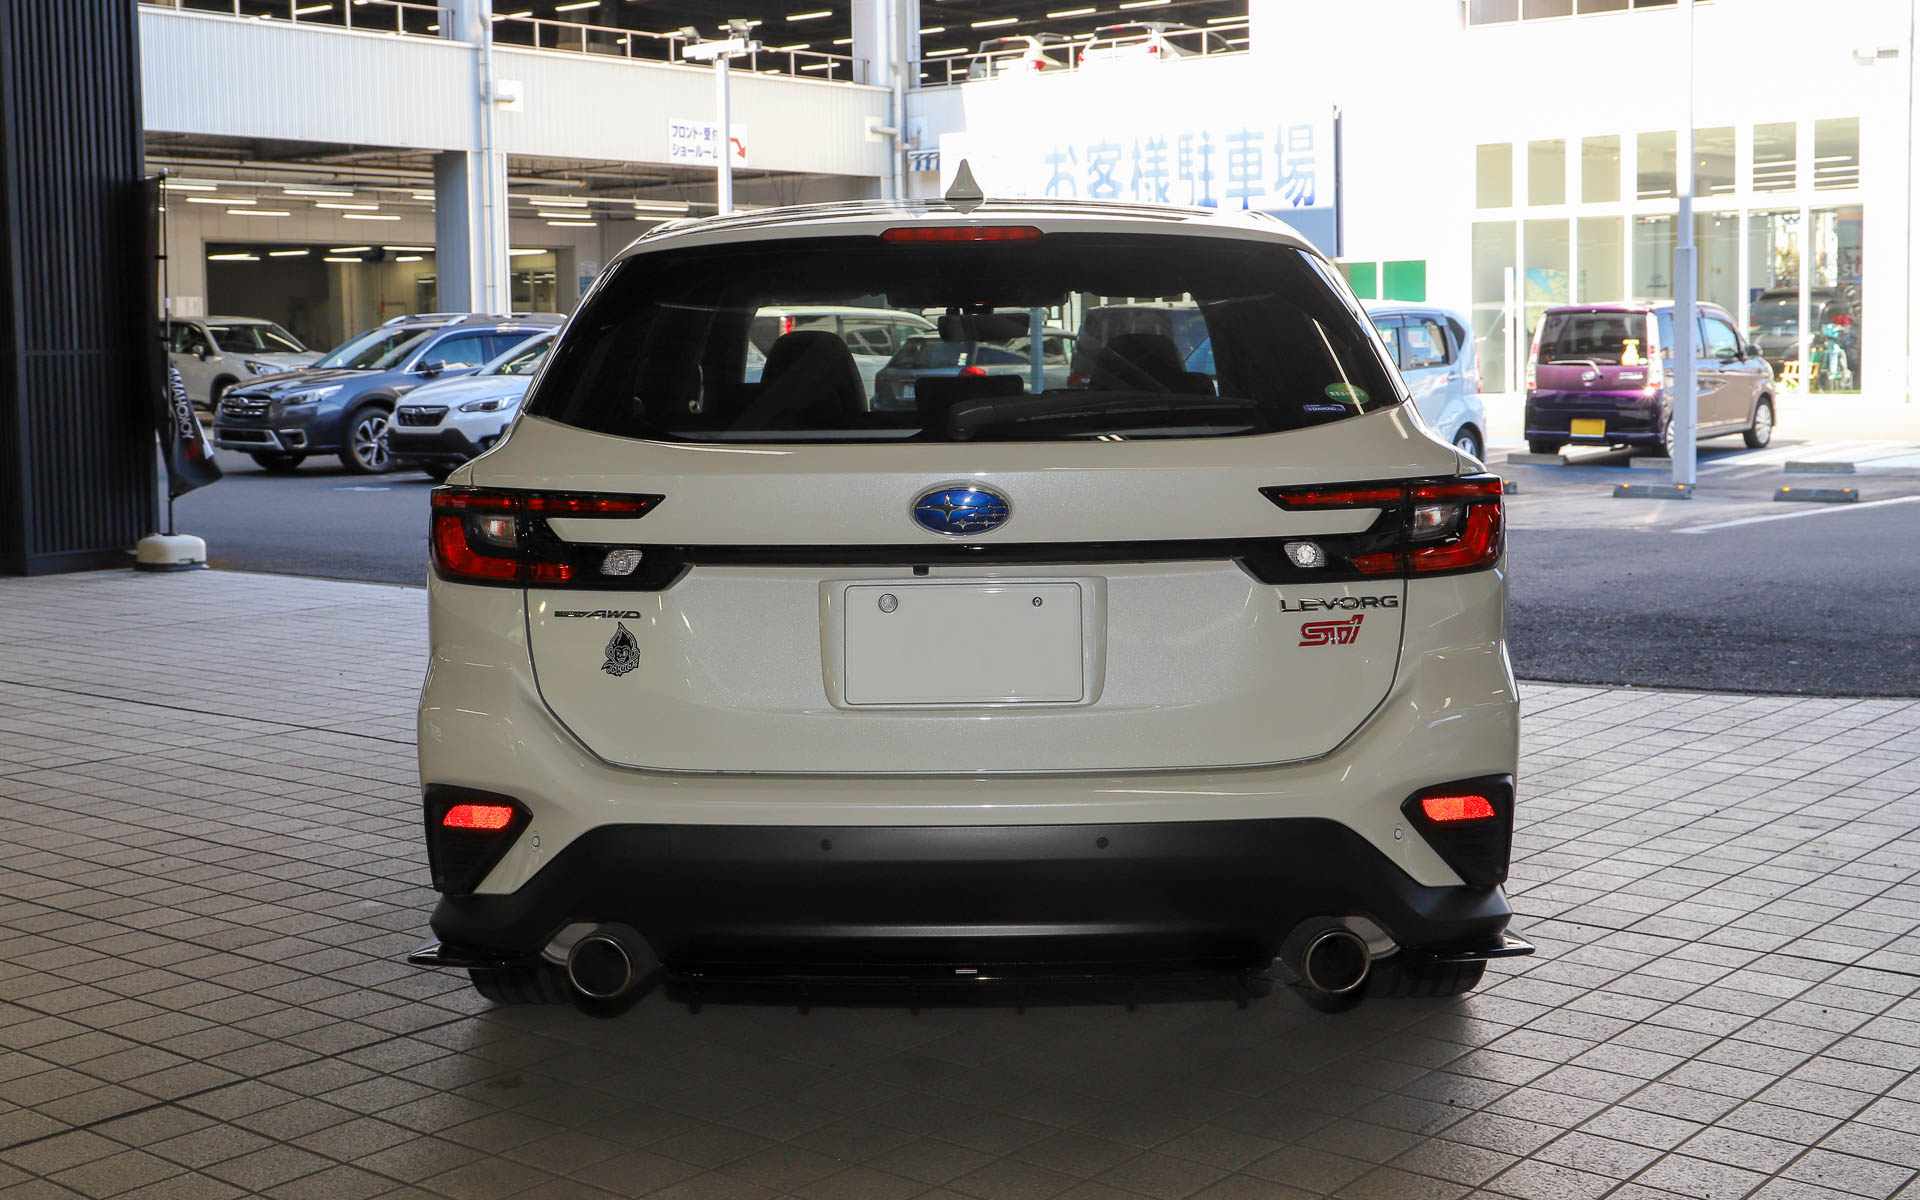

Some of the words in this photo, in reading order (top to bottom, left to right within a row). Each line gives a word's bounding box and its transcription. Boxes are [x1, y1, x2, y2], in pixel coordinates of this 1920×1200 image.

[1045, 124, 1315, 209] お客様駐車場
[1280, 595, 1398, 612] LEVORG
[586, 610, 642, 619] AWD
